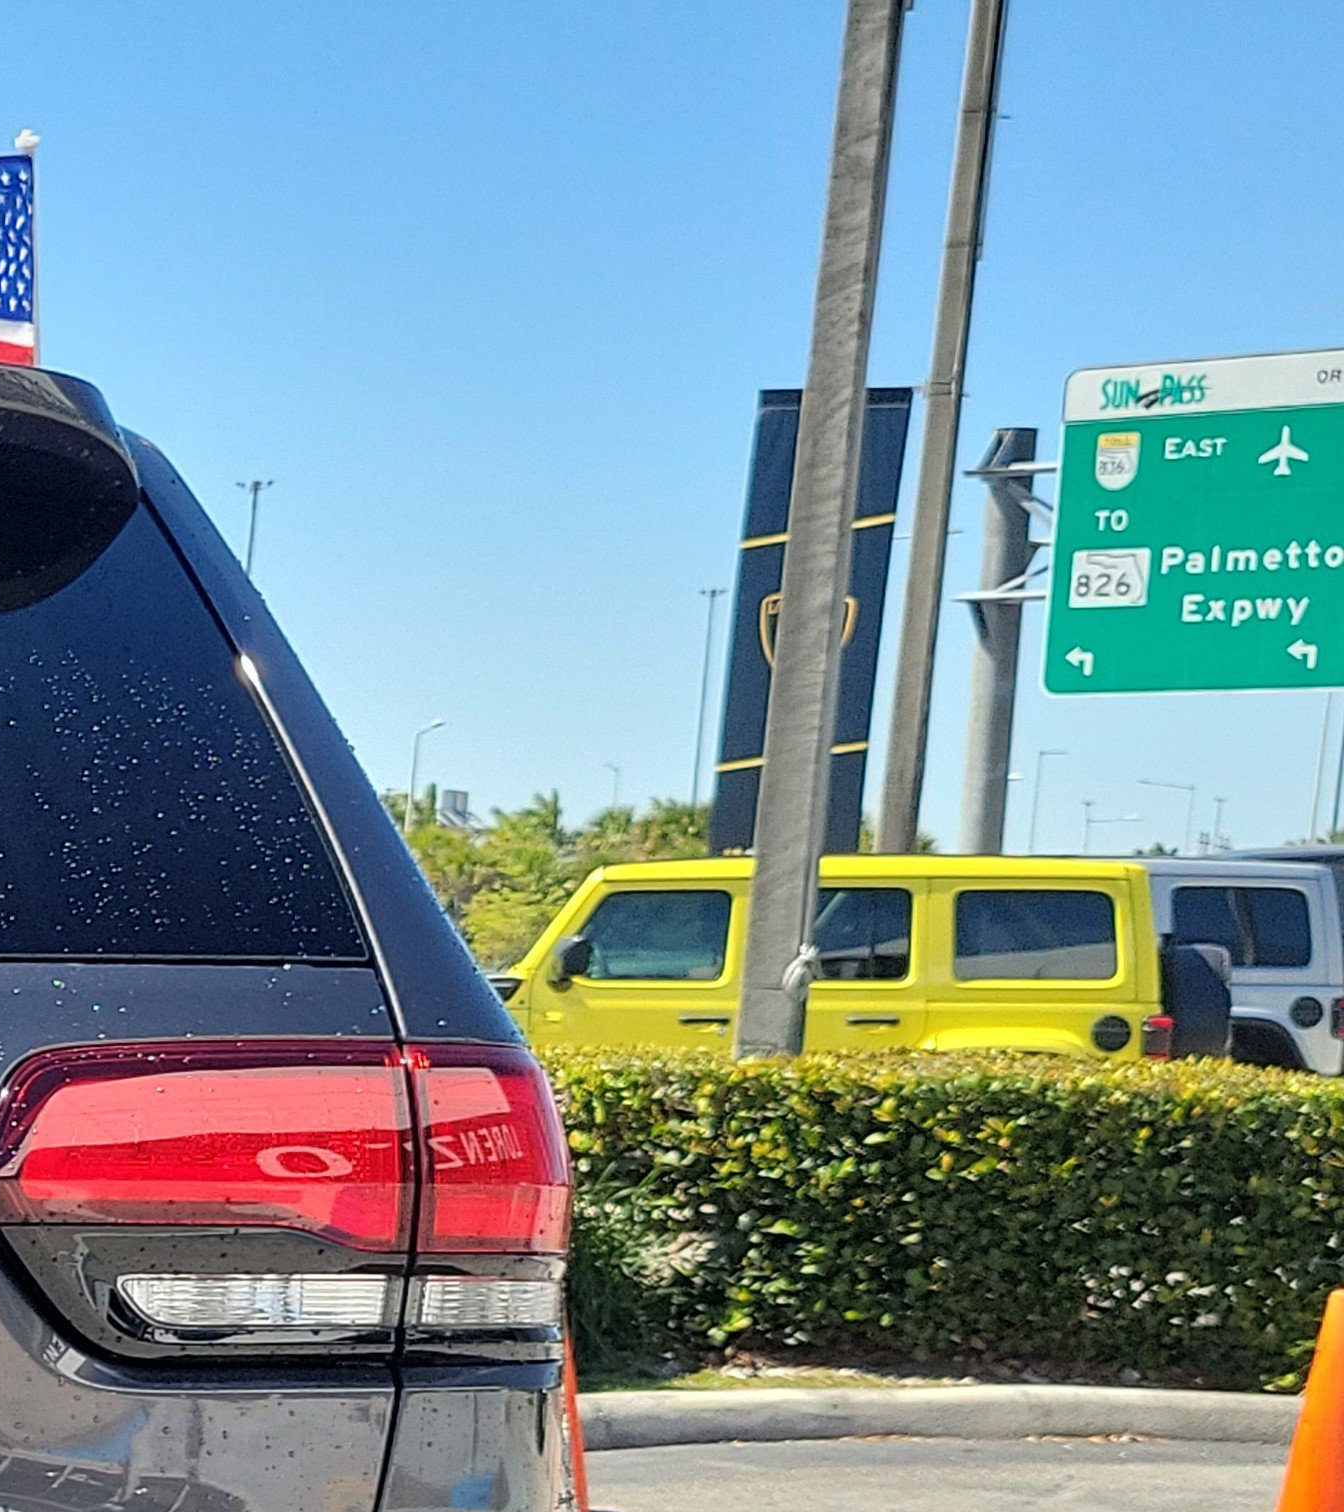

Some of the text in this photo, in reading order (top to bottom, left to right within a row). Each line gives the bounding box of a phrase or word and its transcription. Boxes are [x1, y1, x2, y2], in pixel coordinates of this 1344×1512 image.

[1100, 379, 1141, 410] SUN
[1164, 437, 1228, 459] EAST
[1095, 509, 1129, 531] TO
[1160, 539, 1344, 575] Palmetto
[1076, 571, 1131, 597] 826
[1181, 593, 1310, 627] Expwy
